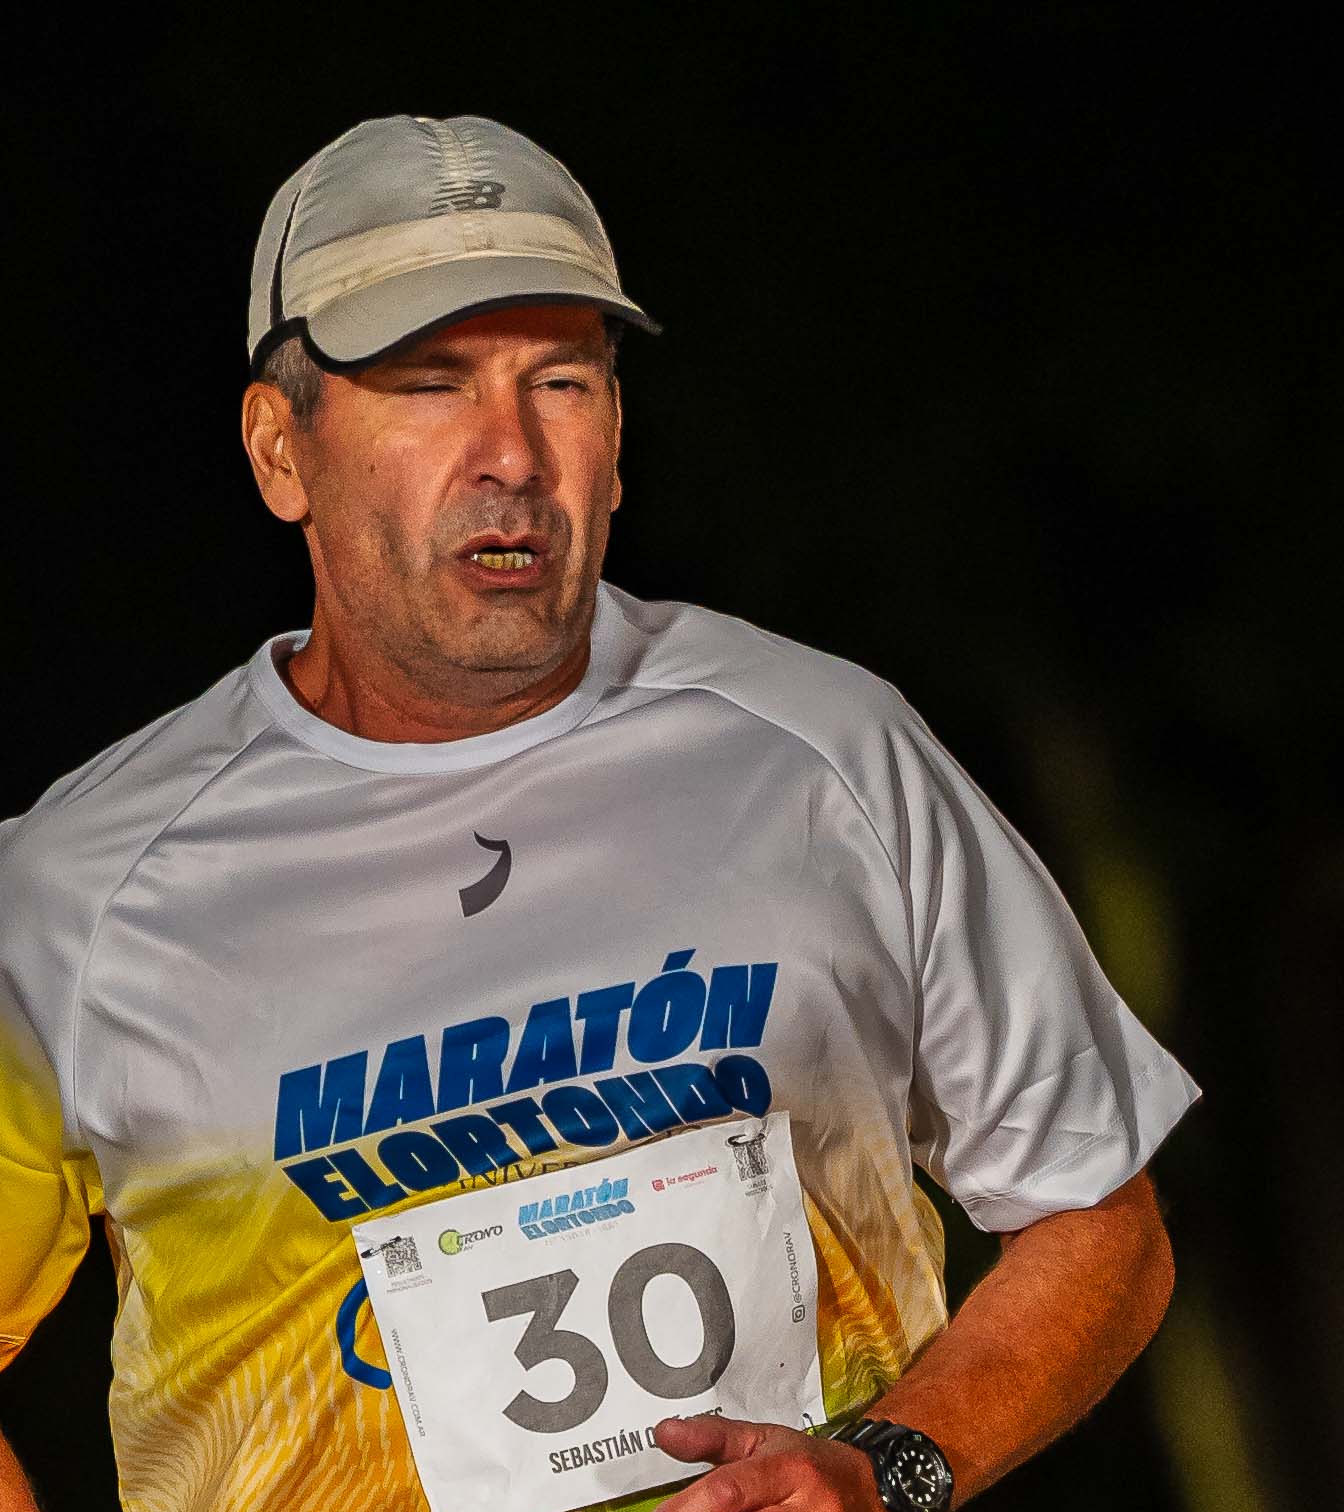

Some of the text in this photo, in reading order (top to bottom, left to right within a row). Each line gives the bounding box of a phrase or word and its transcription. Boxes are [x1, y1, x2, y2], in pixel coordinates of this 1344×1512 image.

[273, 948, 778, 1162] MARATÓN
[282, 1055, 773, 1222] ELORTONDO
[518, 1178, 629, 1228] MARATÓN
[520, 1199, 636, 1241] ELORTONDO
[480, 1241, 736, 1435] 30
[548, 1428, 644, 1474] SEBASTIÁN
